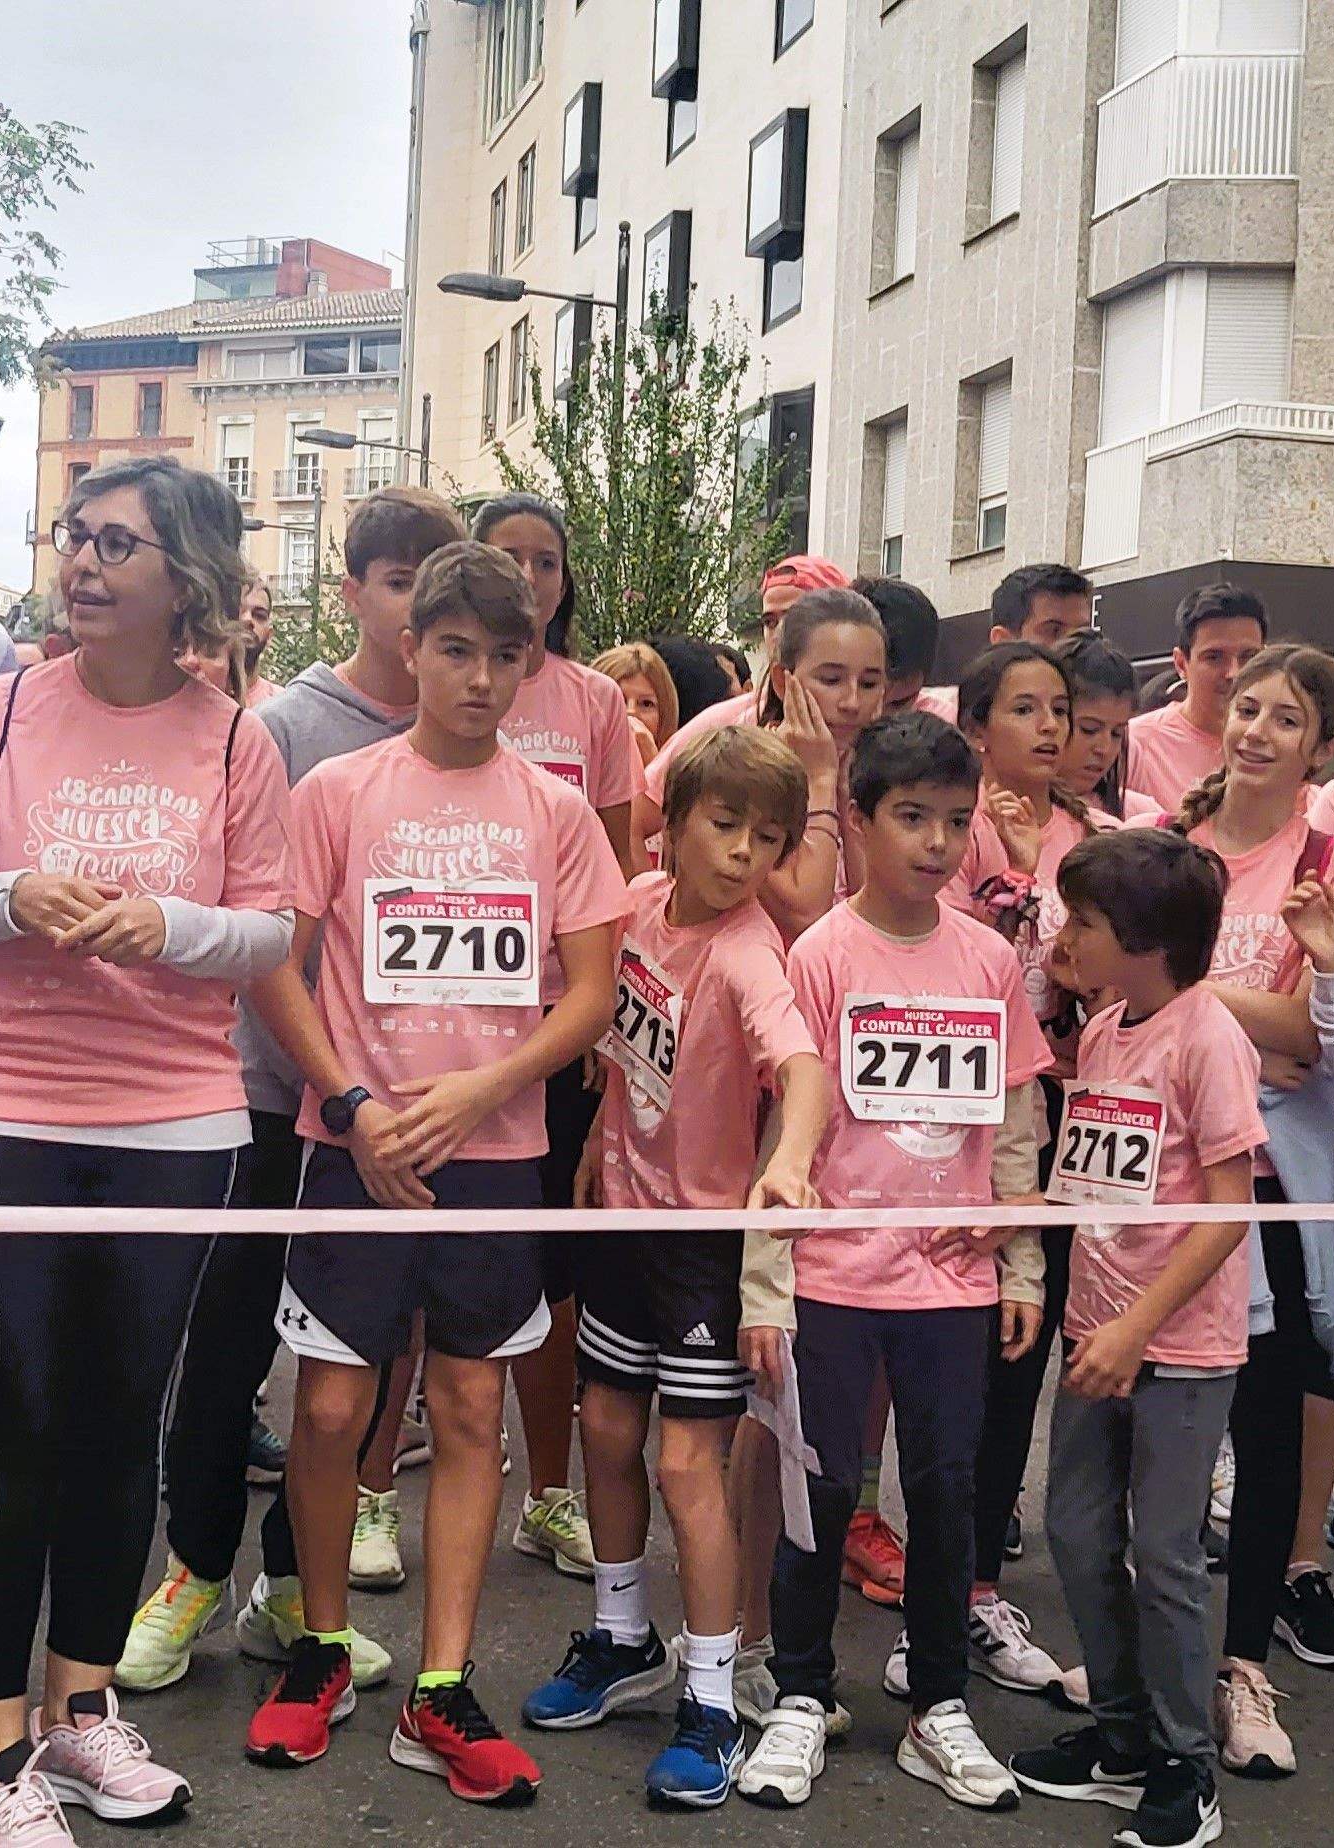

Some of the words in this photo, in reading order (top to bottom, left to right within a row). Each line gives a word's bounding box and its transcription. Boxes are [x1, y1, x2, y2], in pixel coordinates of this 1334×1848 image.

[385, 903, 447, 917] CONTRA
[449, 905, 466, 918] EL
[467, 902, 526, 920] CÁNCER
[434, 894, 477, 906] HUESCA
[383, 924, 527, 973] 2710
[612, 983, 676, 1077] 2713
[859, 1019, 915, 1034] CONTRA
[917, 1022, 934, 1035] EL
[935, 1019, 994, 1037] CÁNCER
[904, 1010, 946, 1021] HUESCA
[856, 1040, 988, 1091] 2711
[1060, 1125, 1150, 1183] 2712
